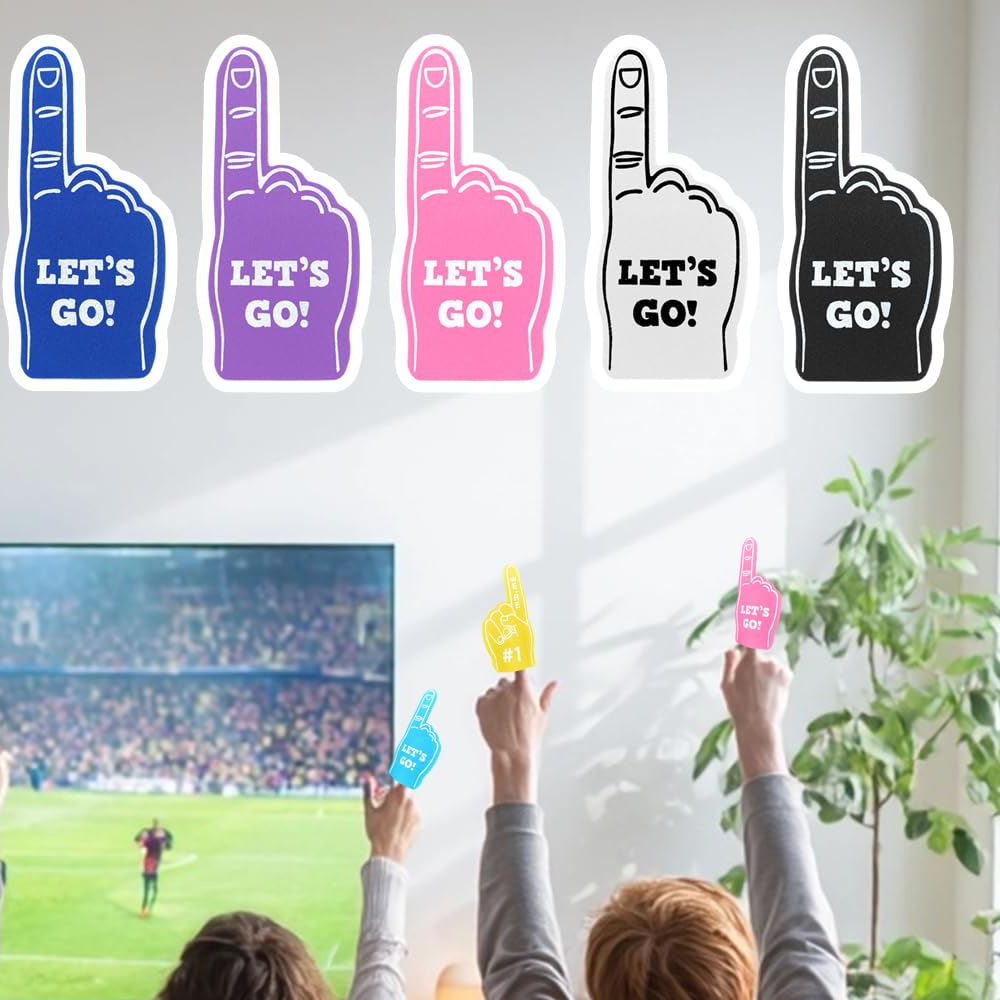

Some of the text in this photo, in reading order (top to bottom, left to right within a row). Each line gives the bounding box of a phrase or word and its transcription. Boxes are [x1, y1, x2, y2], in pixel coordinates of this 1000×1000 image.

[36, 255, 136, 286] LET'S
[230, 256, 330, 288] LET'S
[423, 256, 523, 288] LET'S
[618, 255, 718, 287] LET'S
[811, 256, 912, 289] LET'S
[50, 298, 116, 327] GO!
[244, 299, 310, 328] GO!
[437, 299, 503, 329] GO!
[632, 298, 698, 328] GO!
[826, 300, 891, 329] GO!
[740, 604, 770, 618] LET'S
[742, 618, 762, 631] GO!
[502, 646, 521, 663] #1
[399, 755, 417, 772] GO!
[401, 743, 428, 763] LET'S
